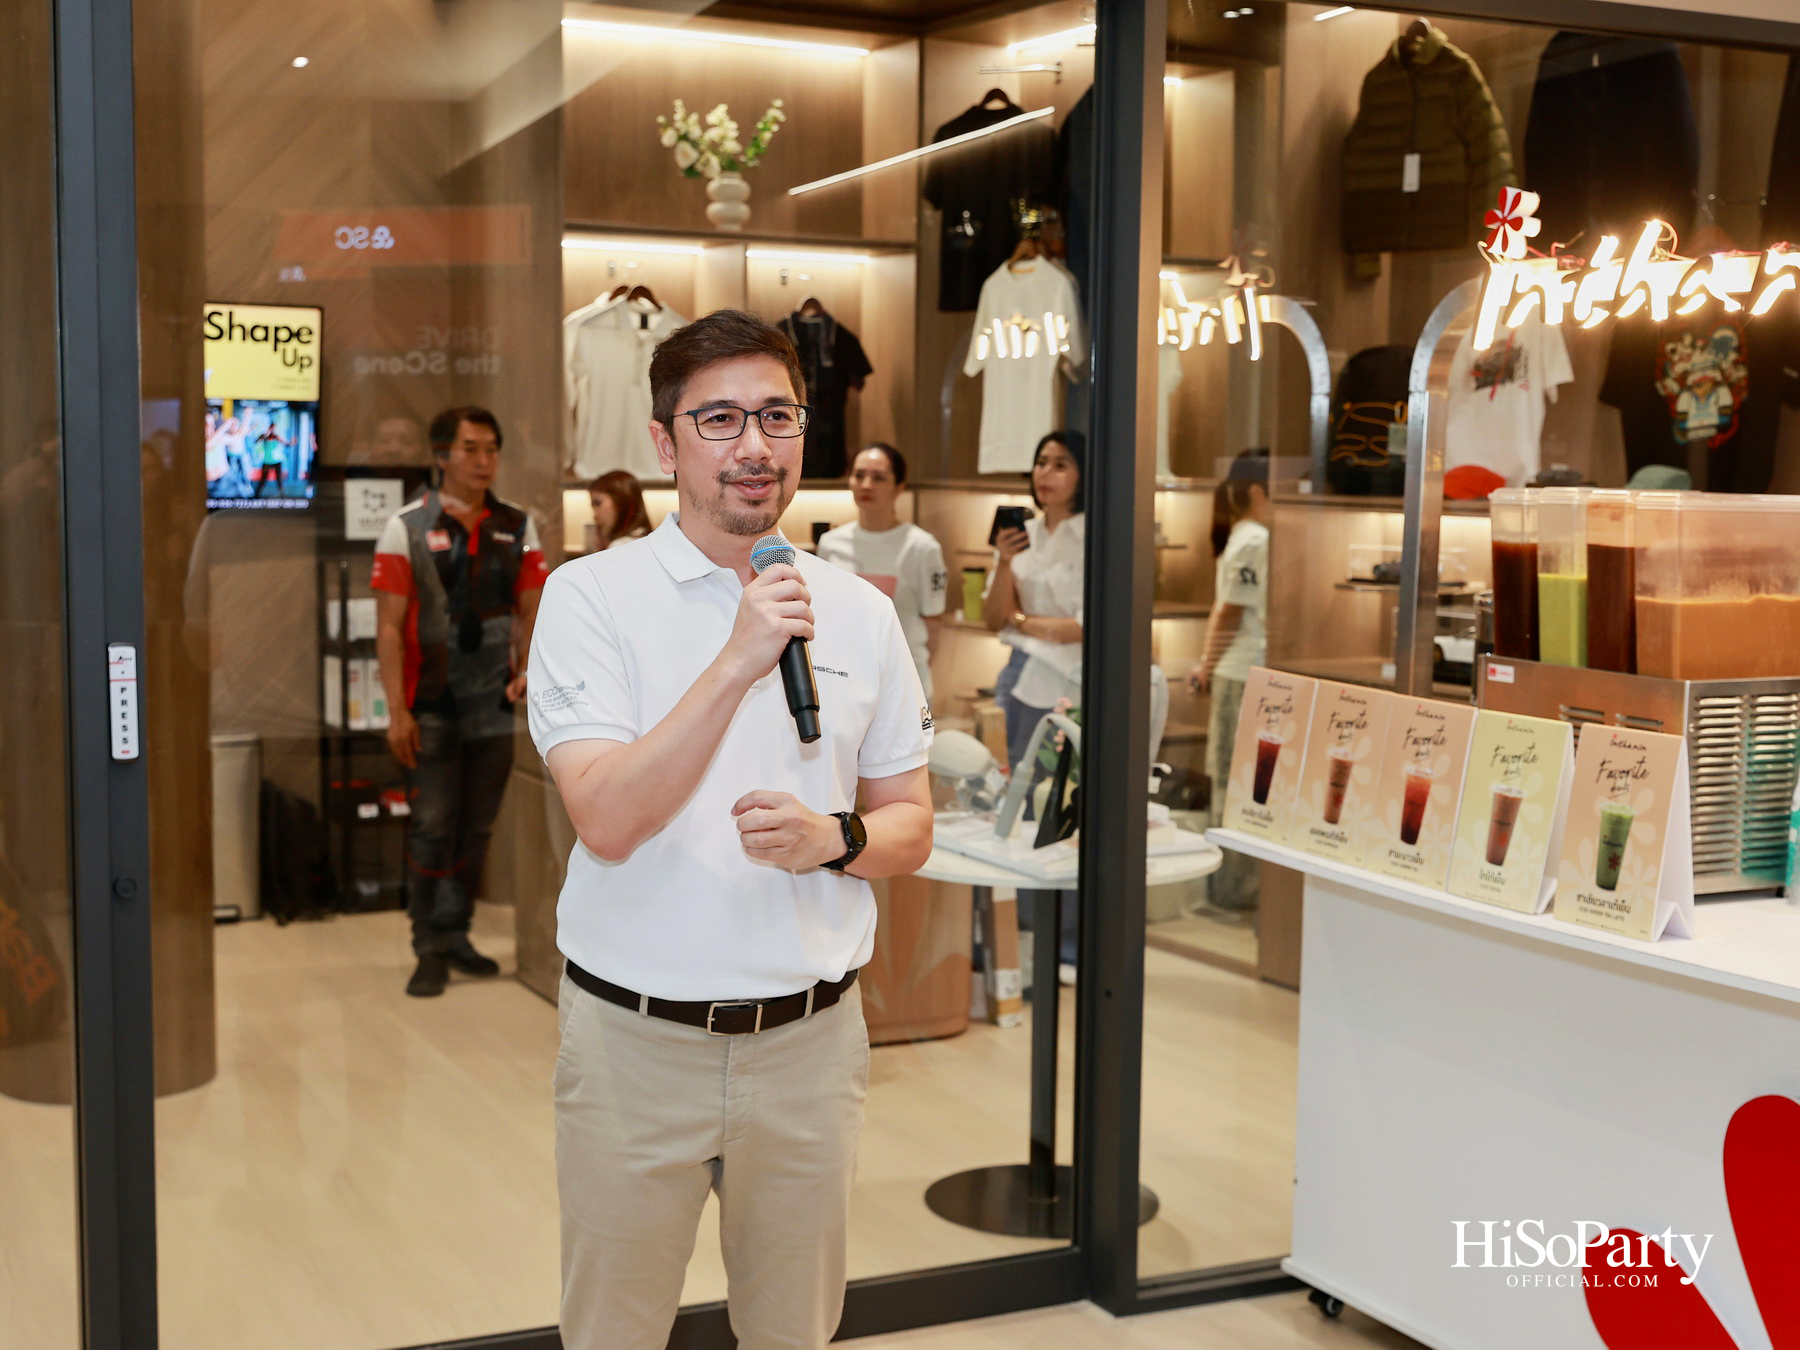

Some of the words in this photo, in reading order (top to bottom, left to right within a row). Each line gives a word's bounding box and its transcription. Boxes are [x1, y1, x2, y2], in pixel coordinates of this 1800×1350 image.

[203, 311, 313, 352] Shape
[282, 348, 313, 373] Up
[1596, 756, 1650, 784] Favorite
